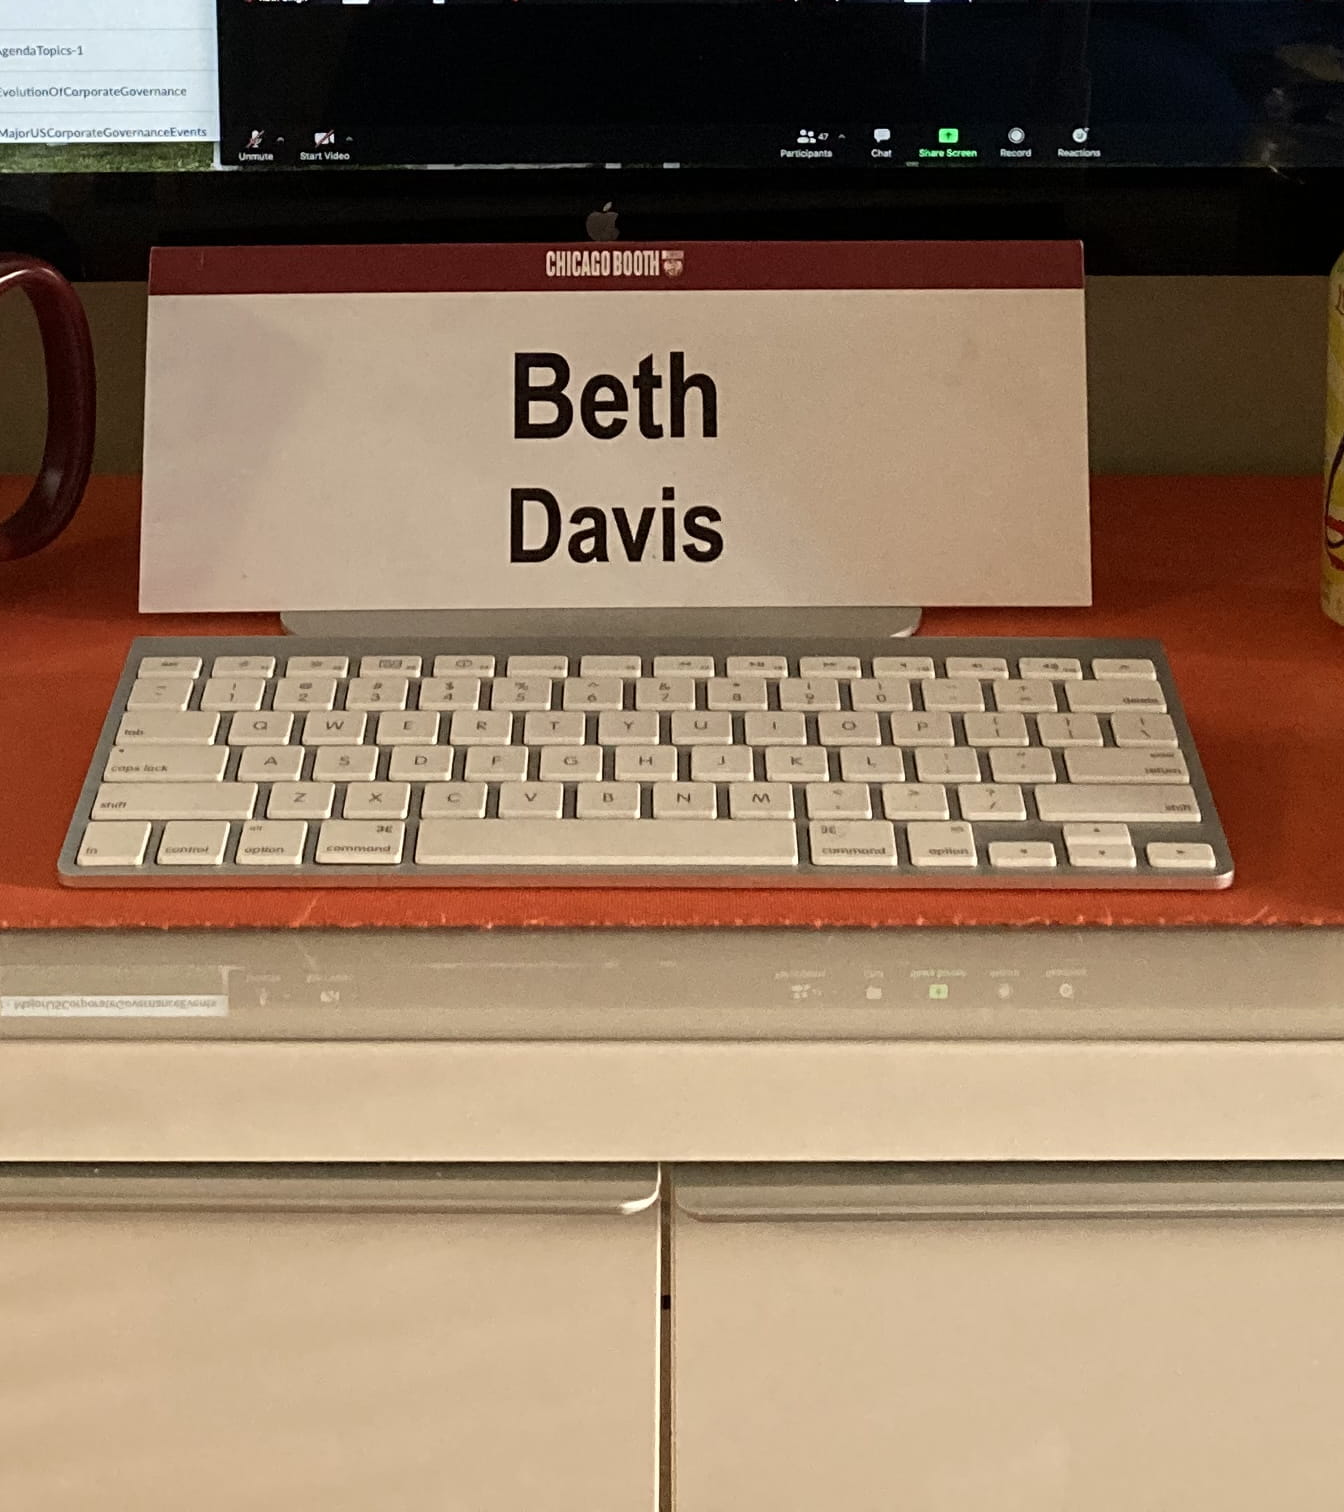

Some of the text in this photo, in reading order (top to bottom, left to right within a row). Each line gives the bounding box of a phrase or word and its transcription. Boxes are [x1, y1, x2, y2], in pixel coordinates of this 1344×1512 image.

[780, 149, 832, 158] Participants
[919, 149, 977, 157] Share Screen
[546, 250, 659, 276] CHICAGO BOOTH
[514, 352, 717, 439] Beth
[510, 487, 723, 563] Davis
